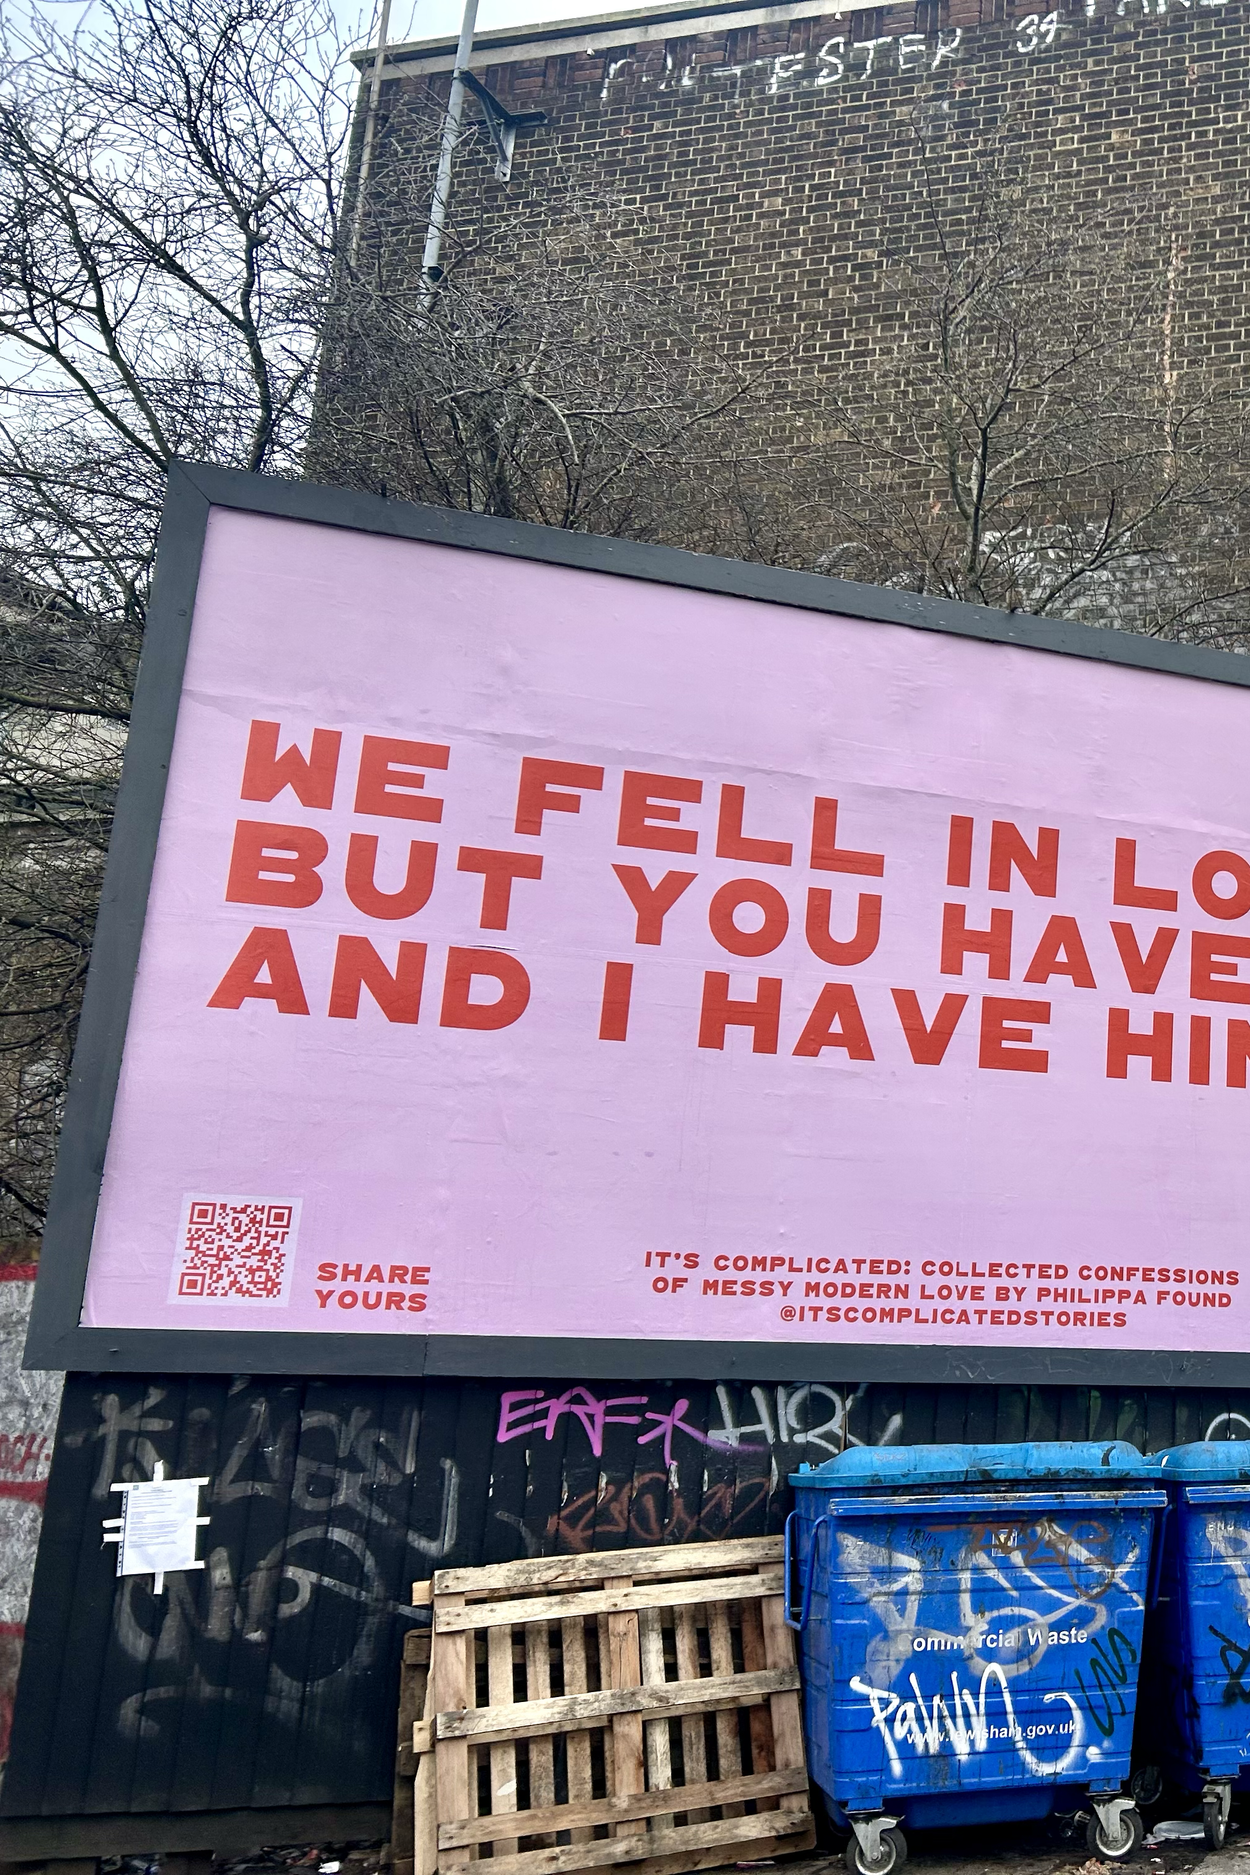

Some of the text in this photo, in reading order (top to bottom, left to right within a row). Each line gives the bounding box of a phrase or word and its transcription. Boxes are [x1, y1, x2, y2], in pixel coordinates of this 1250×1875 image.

[242, 721, 449, 822] WE
[516, 758, 883, 876] FELL
[947, 816, 1058, 897] IN
[227, 820, 542, 929] BUT
[613, 864, 881, 965] YOU
[208, 927, 529, 1030] AND
[600, 962, 632, 1040] I
[699, 971, 1050, 1072] HAVE
[316, 1262, 431, 1285] SHARE
[645, 1251, 1239, 1286] IT'S COMPLICATED: COLLECTED CONFESSIONS
[314, 1289, 428, 1312] YOURS
[652, 1276, 1232, 1308] OF MESSY MODERN LOVE BY PHILIPPA FOUND
[780, 1305, 1127, 1328] @ITSCOMPLICATEDSTORIES
[1027, 1626, 1088, 1646] Waste
